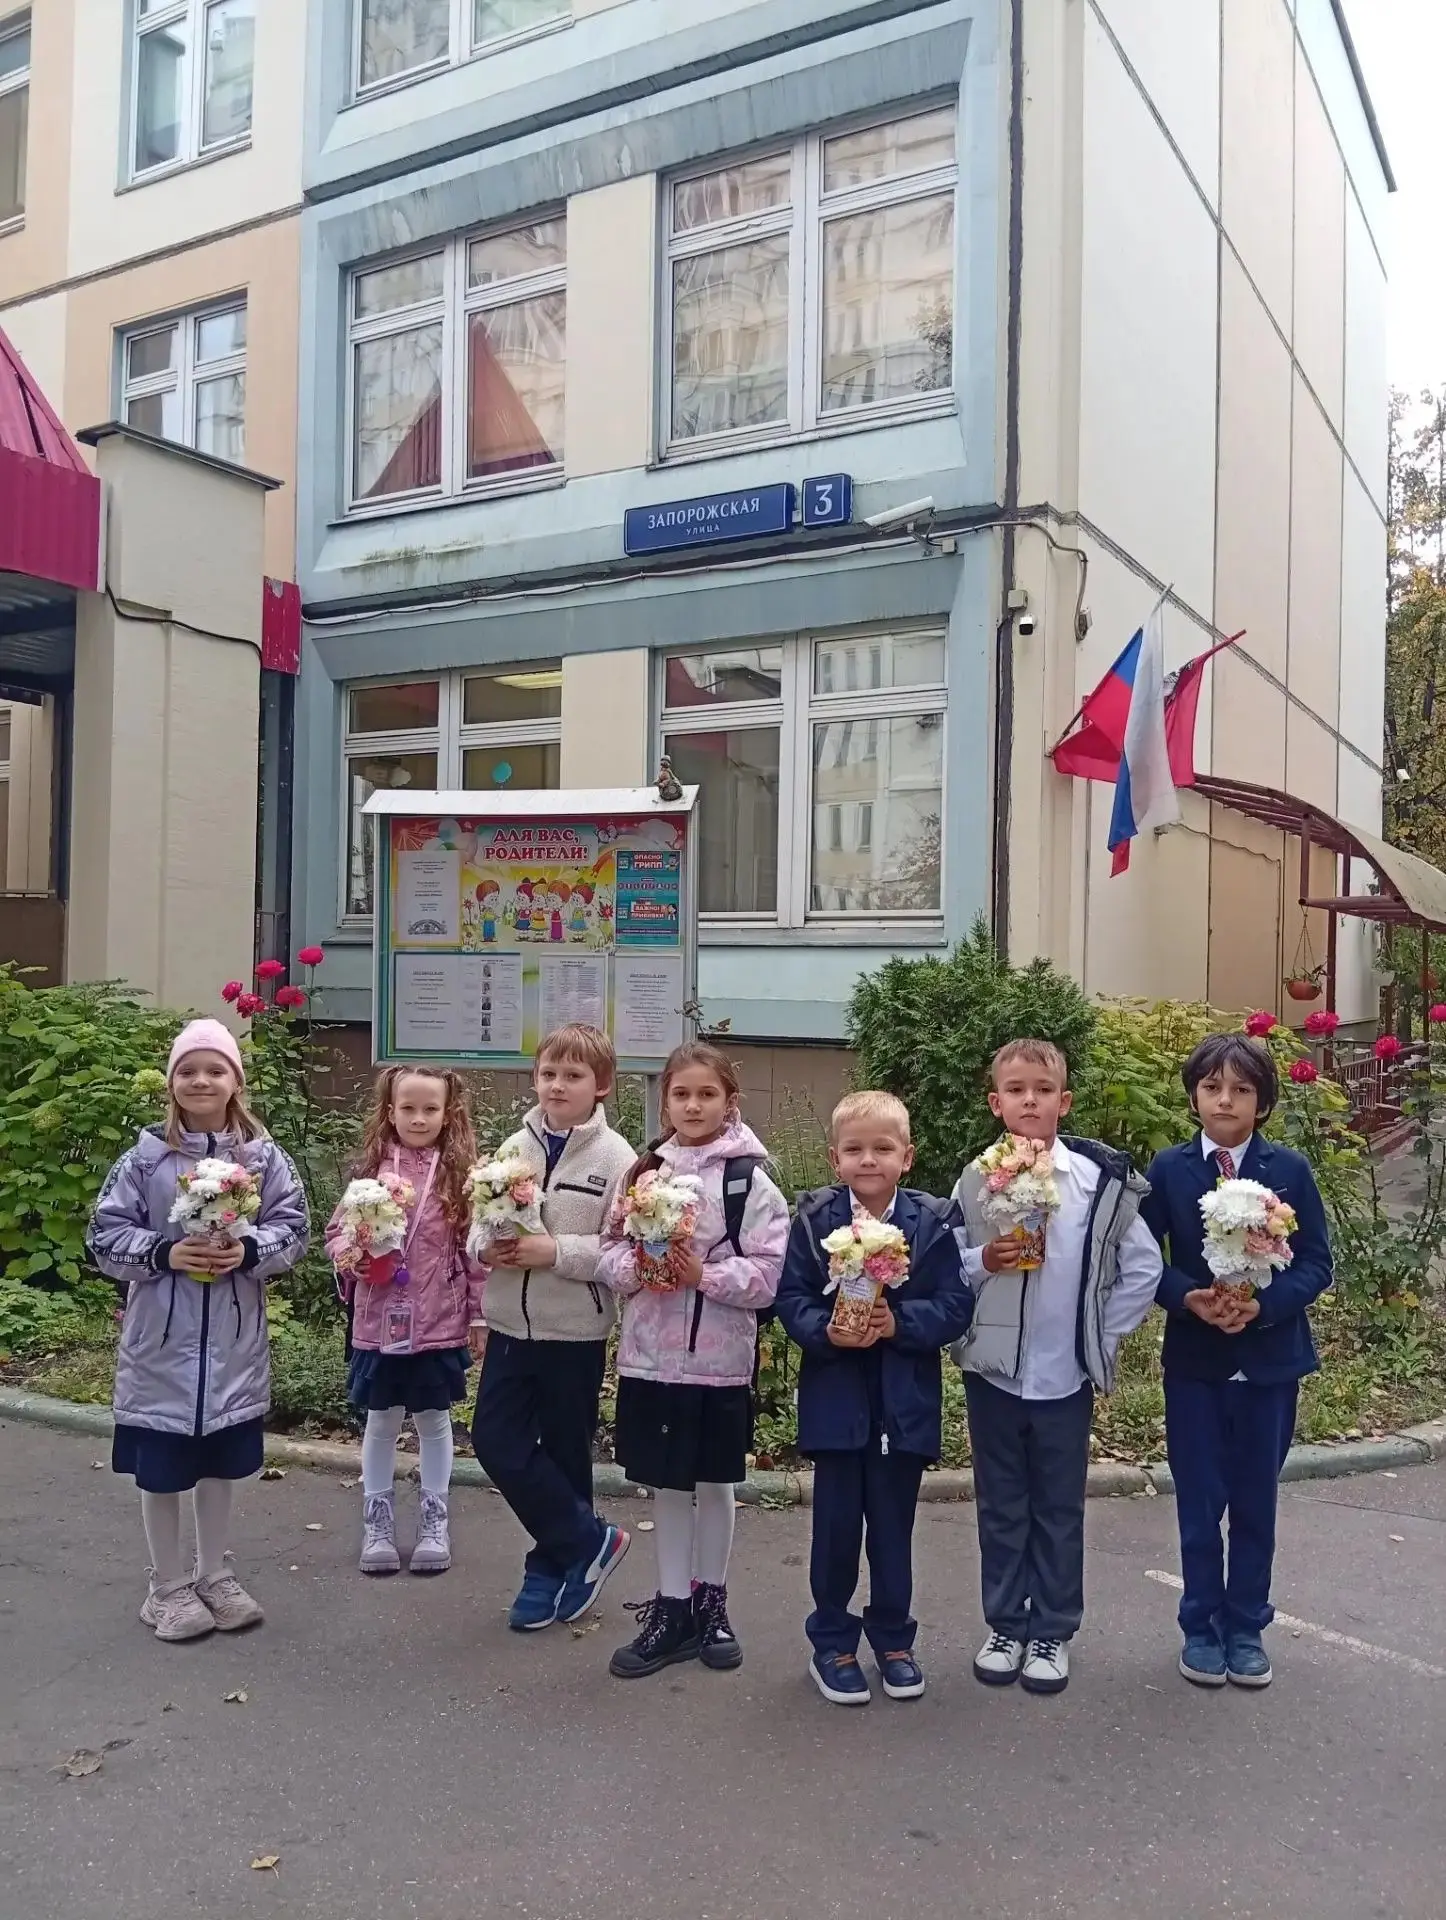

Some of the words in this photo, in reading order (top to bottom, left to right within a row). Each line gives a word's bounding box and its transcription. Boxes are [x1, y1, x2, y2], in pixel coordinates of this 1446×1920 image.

[813, 483, 833, 516] 3
[648, 497, 760, 530] ЗАПОРОЖСКАЯ
[686, 523, 720, 536] УЛИЦА
[493, 829, 533, 843] ДЛЯ
[537, 829, 579, 844] ВАС,
[485, 847, 588, 860] РОДИТЕЛИ!
[634, 861, 663, 869] ГРИПП
